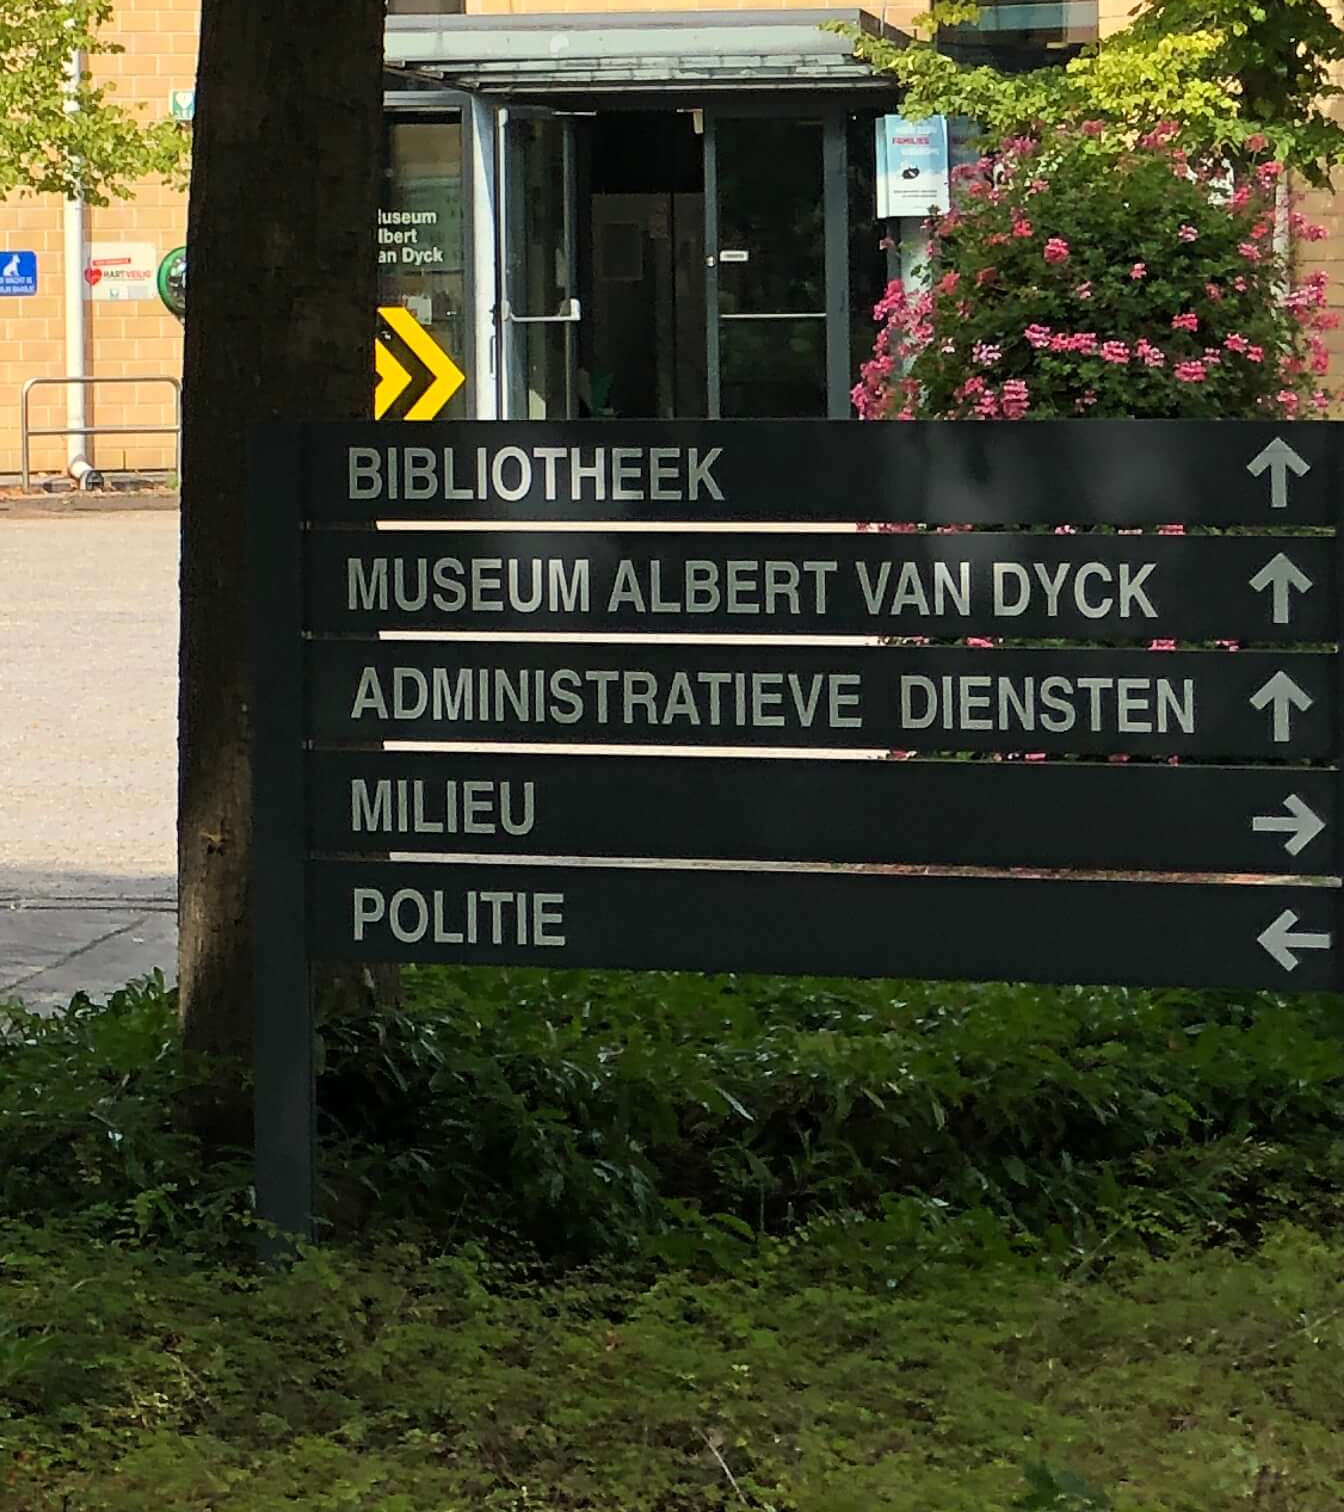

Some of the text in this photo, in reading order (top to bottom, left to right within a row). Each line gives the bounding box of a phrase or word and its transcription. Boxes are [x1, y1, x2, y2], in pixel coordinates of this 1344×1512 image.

[377, 208, 437, 225] useum
[377, 227, 418, 244] lbert
[377, 246, 444, 266] an Dyck
[347, 445, 726, 502] BIBLIOTHEEK
[347, 557, 1160, 620] MUSEUM ALBERT VAN DYCK
[350, 666, 1196, 735] ADMINISTRATIEVE DIENSTEN
[351, 779, 535, 836] MILIEU
[353, 887, 566, 947] POLITIE
